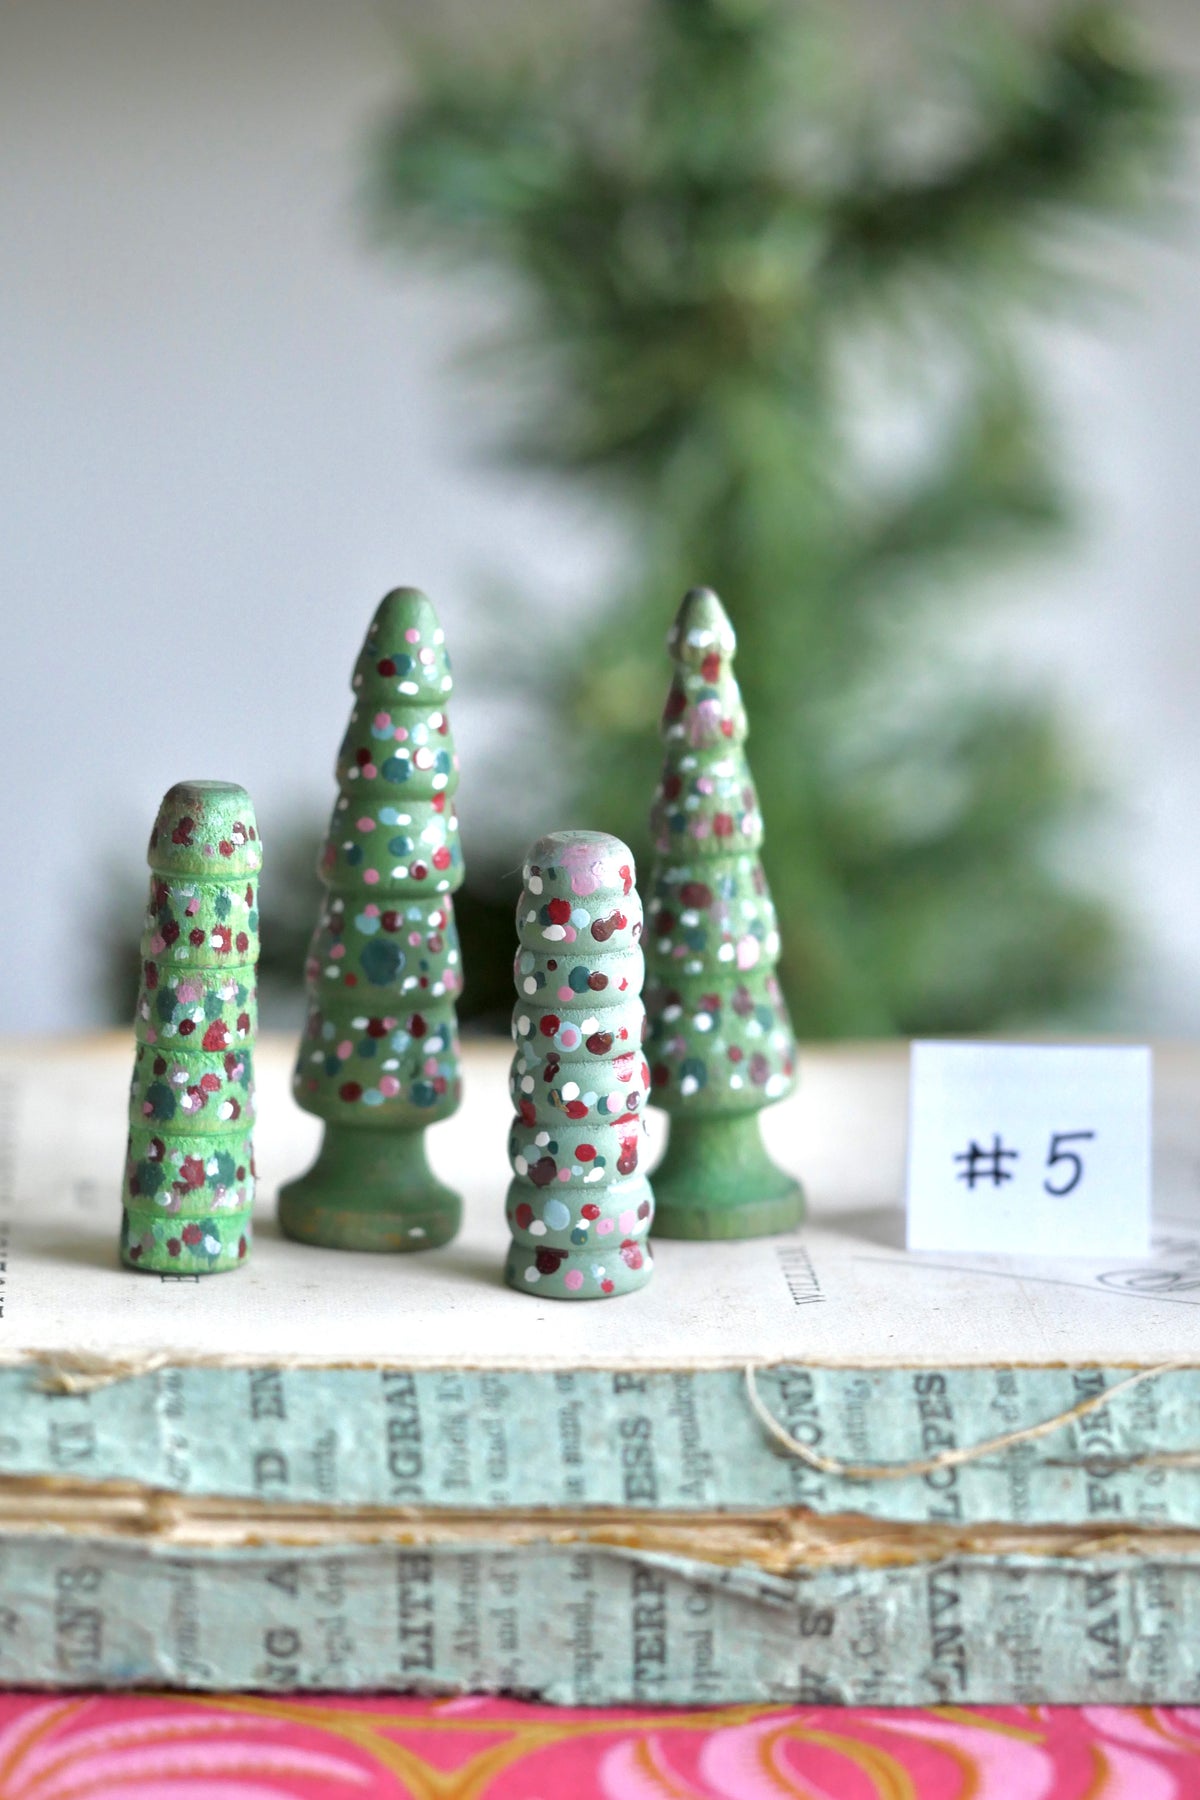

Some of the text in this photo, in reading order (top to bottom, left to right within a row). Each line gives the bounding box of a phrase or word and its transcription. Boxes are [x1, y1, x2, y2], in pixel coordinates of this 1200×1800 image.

[952, 1130, 1095, 1196] # 5
[619, 1416, 658, 1503] ESS
[913, 1372, 962, 1523] LOPES
[399, 1551, 435, 1673] LITH
